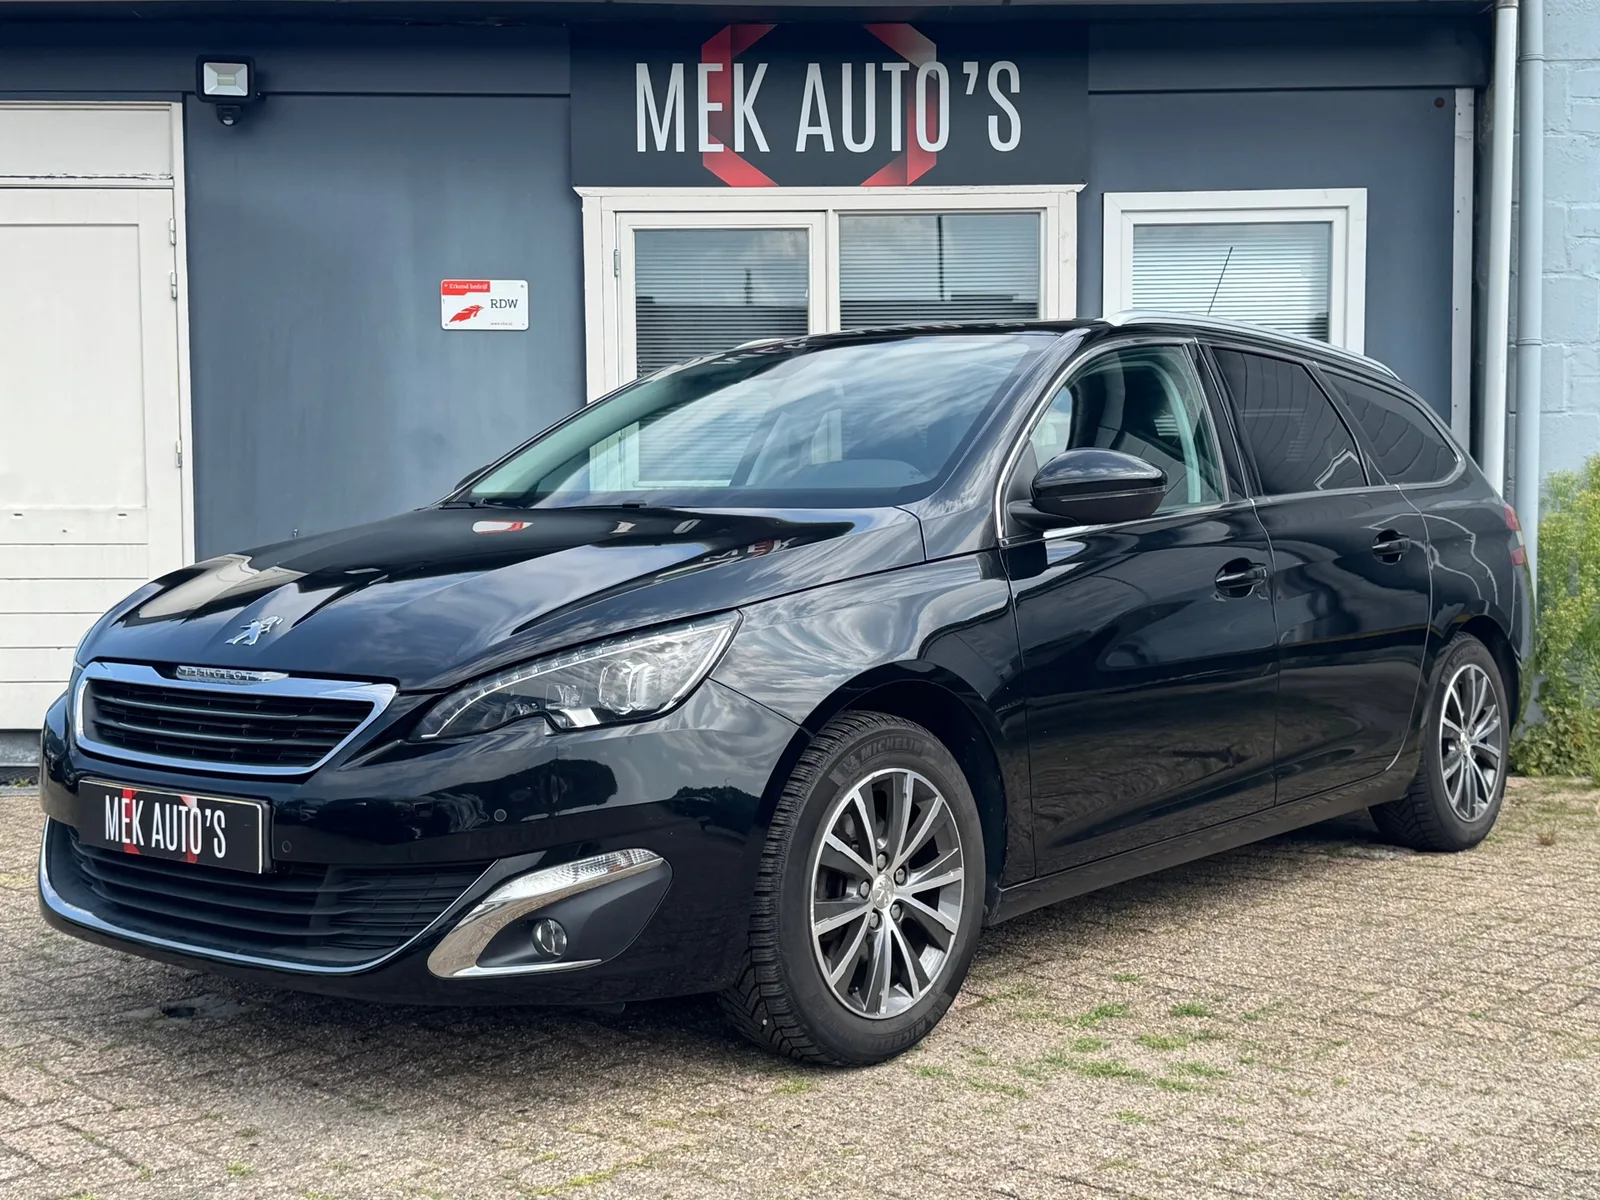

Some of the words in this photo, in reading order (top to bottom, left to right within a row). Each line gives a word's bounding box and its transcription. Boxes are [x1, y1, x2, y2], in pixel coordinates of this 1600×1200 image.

[636, 62, 770, 153] MEK
[795, 60, 1022, 153] AUTO'S
[470, 283, 488, 291] bedrijf
[490, 298, 518, 309] RDW
[185, 667, 252, 680] PEUGEOT
[105, 794, 145, 847] MEK
[151, 802, 227, 859] AUTO'S
